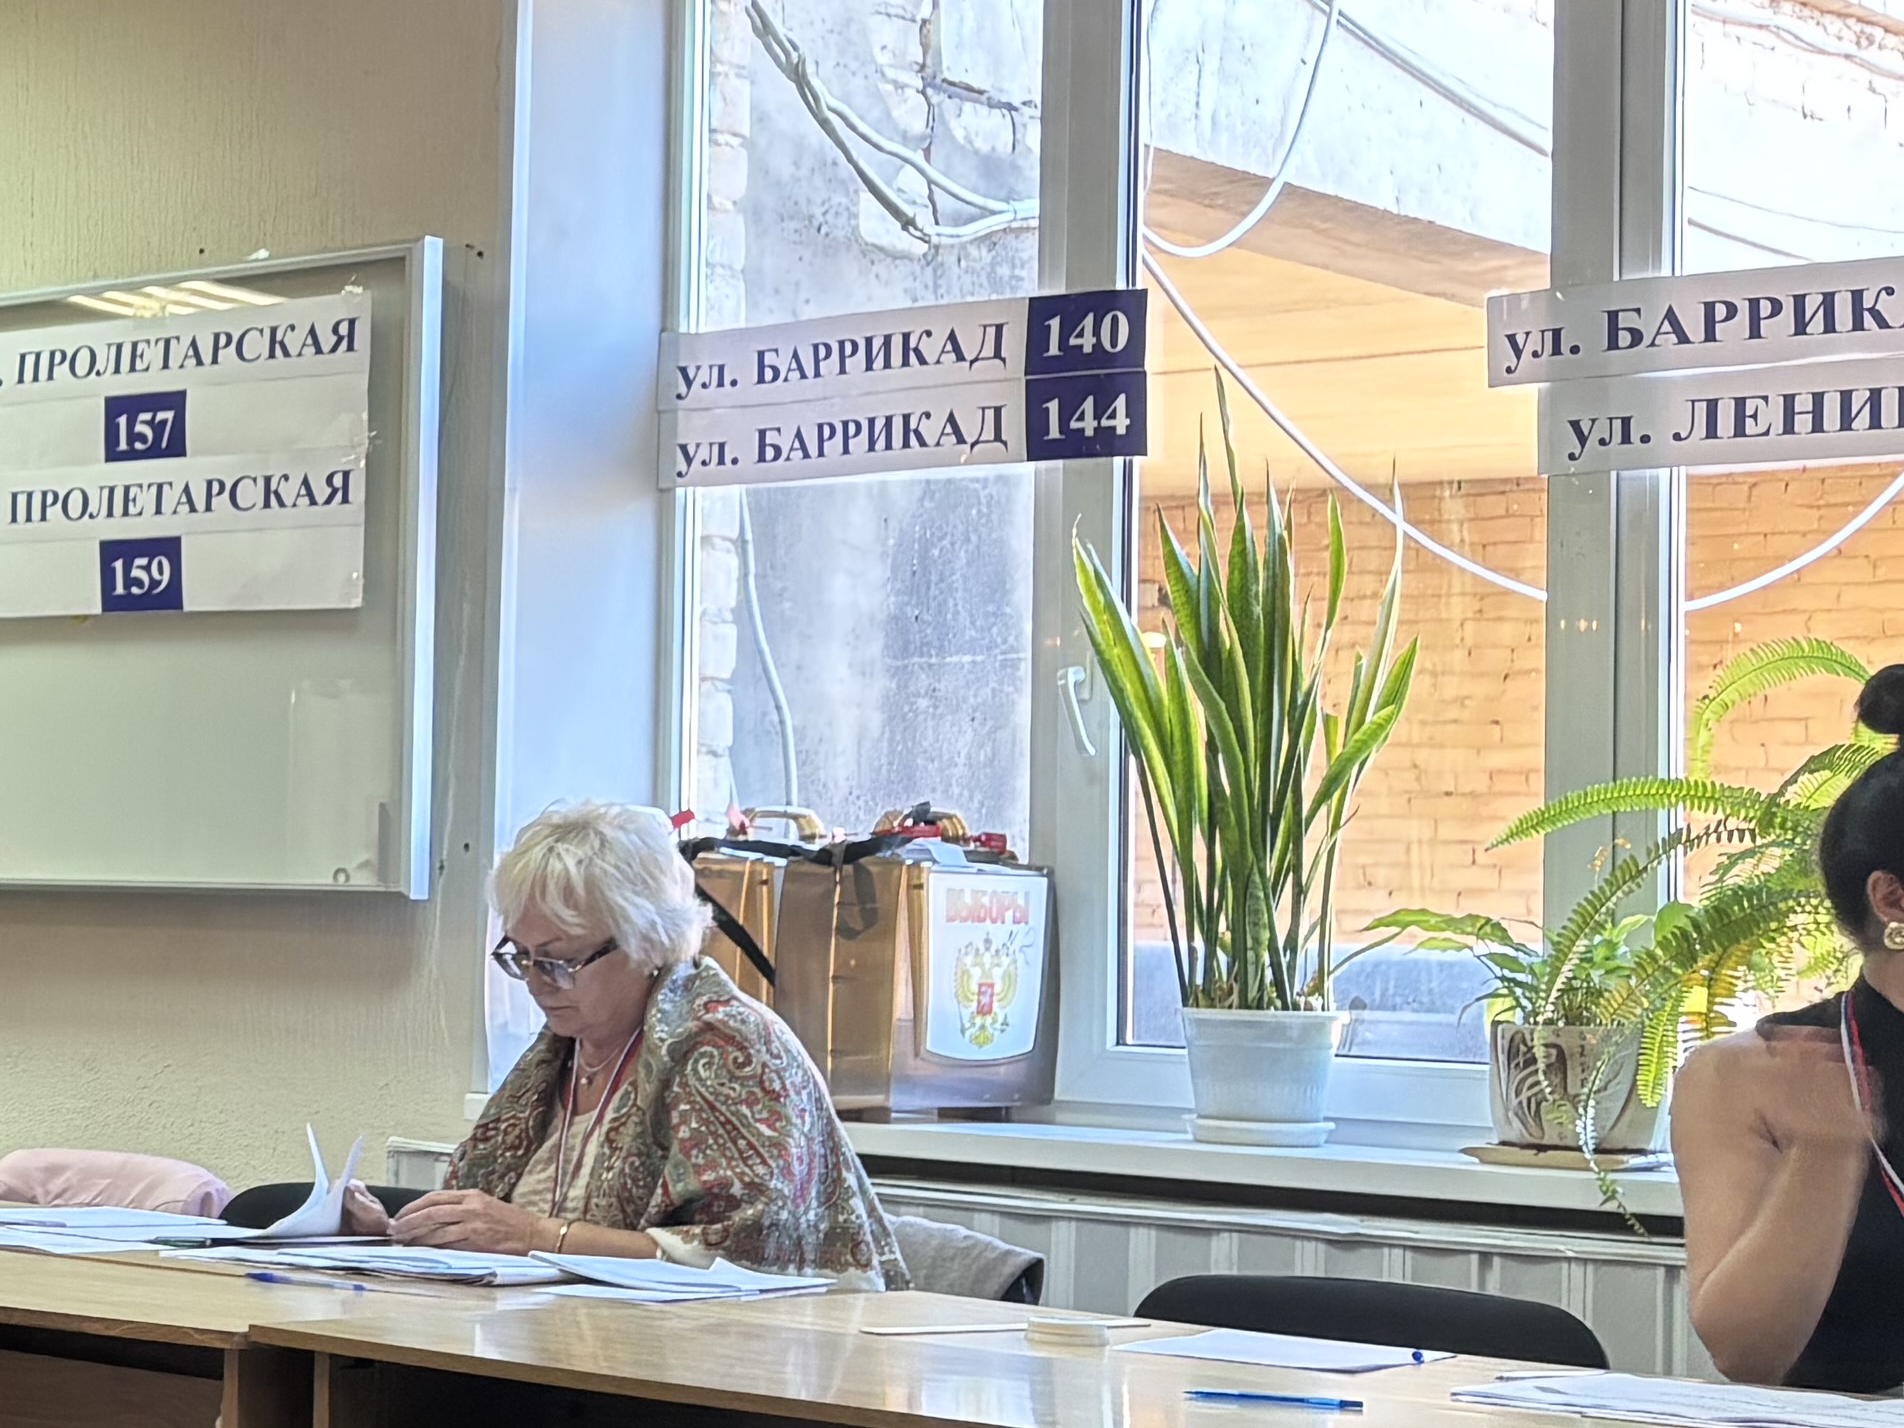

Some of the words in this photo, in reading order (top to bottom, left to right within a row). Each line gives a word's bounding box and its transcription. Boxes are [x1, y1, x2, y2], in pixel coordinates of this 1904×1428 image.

[15, 316, 361, 386] ПРОЛЕТАРСКАЯ
[674, 363, 739, 401] ул.
[752, 321, 1009, 387] БАРРИКАД
[1042, 308, 1130, 357] 140
[1504, 326, 1582, 375] ул.
[1601, 285, 1904, 352] БАРРИК
[113, 409, 176, 453] 157
[675, 442, 740, 478] ул.
[752, 403, 1009, 466] БАРРИКАД
[1041, 391, 1132, 441] 144
[1566, 415, 1652, 462] ул.
[1671, 386, 1904, 442] ЛЕНИ
[8, 468, 355, 526] ПРОЛЕТАРСКАЯ
[111, 555, 173, 597] 159
[946, 888, 1030, 925] ВЫБОРЫ
